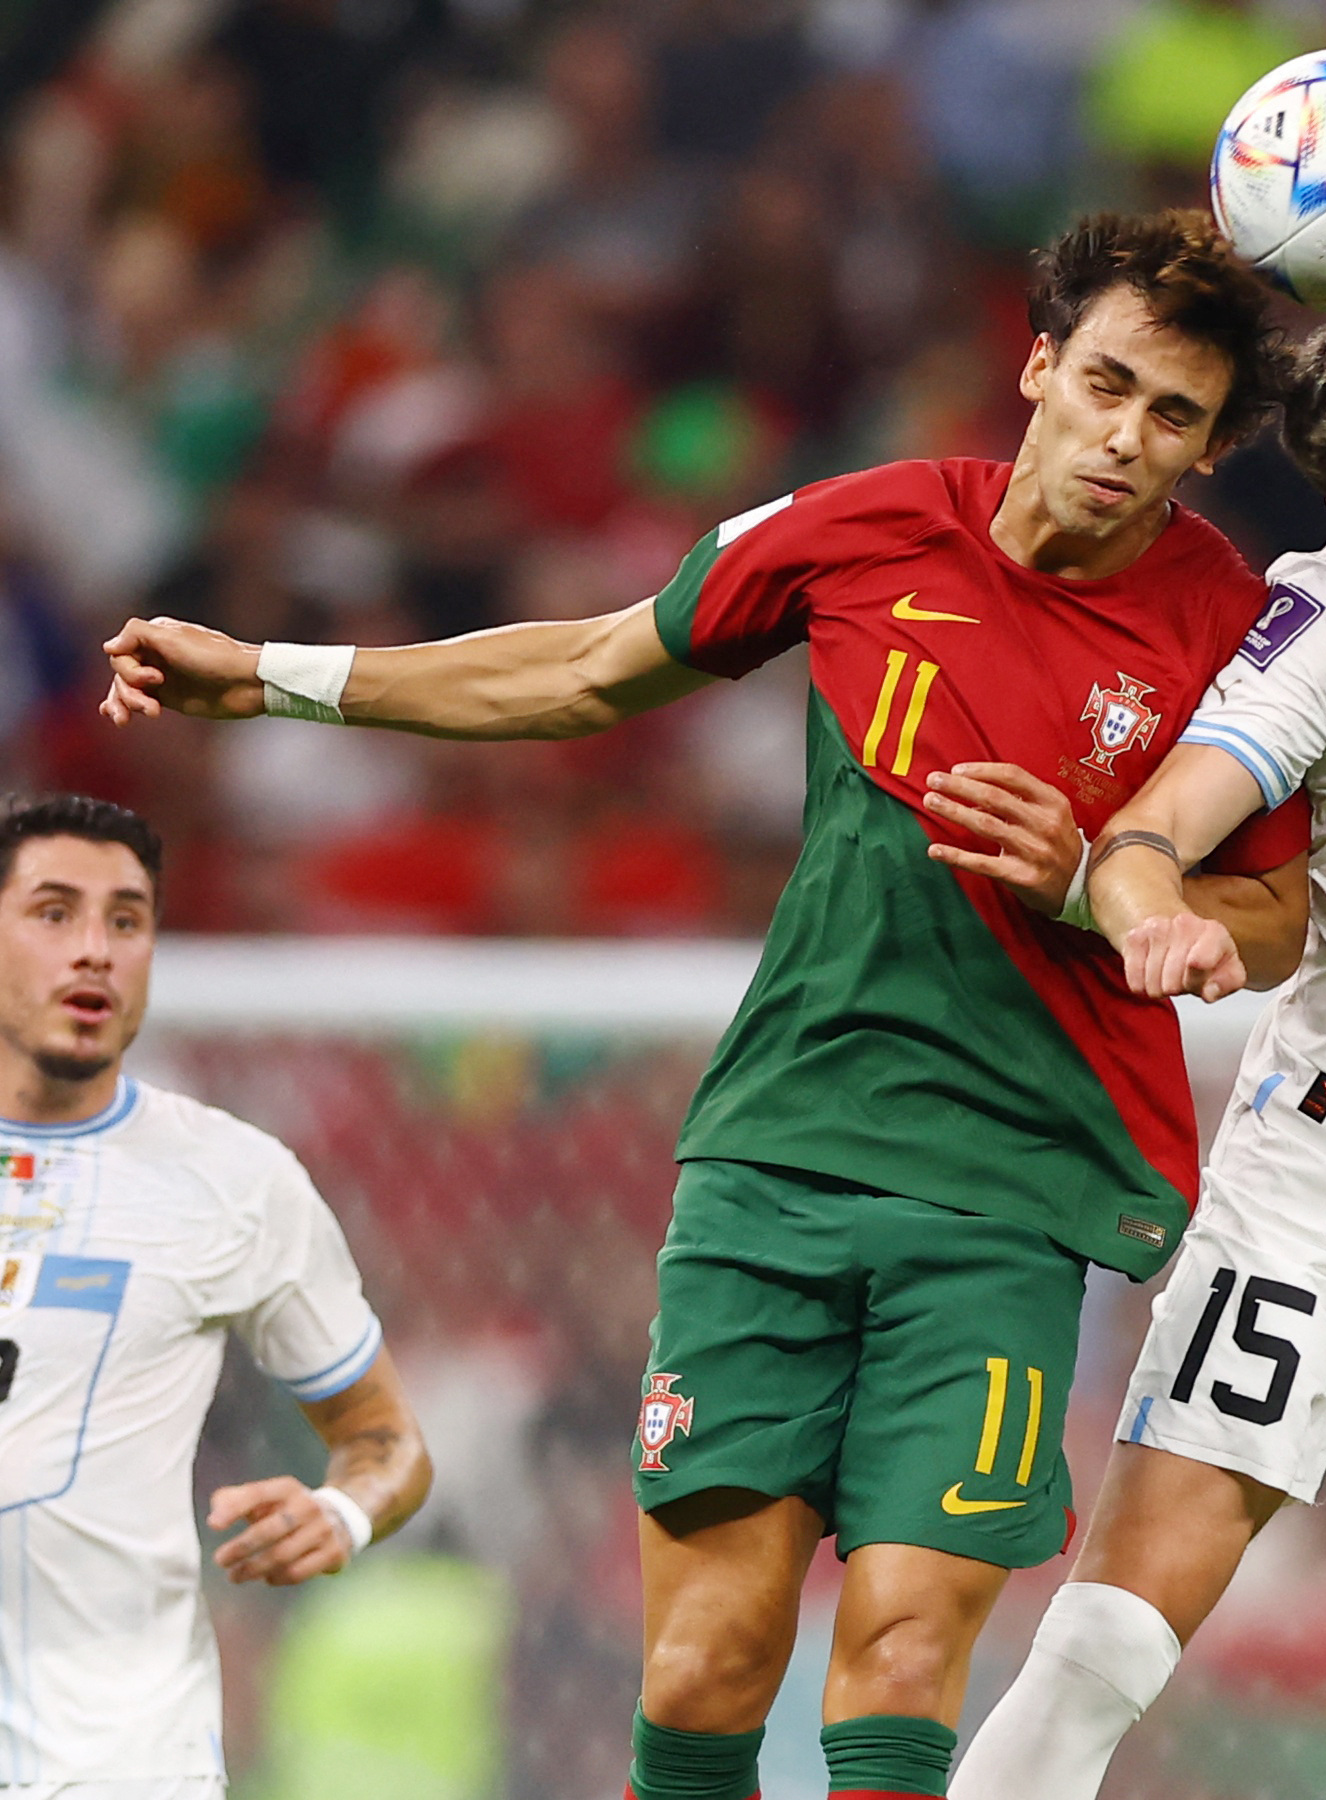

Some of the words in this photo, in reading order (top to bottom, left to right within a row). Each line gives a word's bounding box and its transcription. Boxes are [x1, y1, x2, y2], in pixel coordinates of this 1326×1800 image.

[863, 649, 941, 776] 11
[1169, 1267, 1317, 1426] 15
[974, 1357, 1043, 1487] 11
